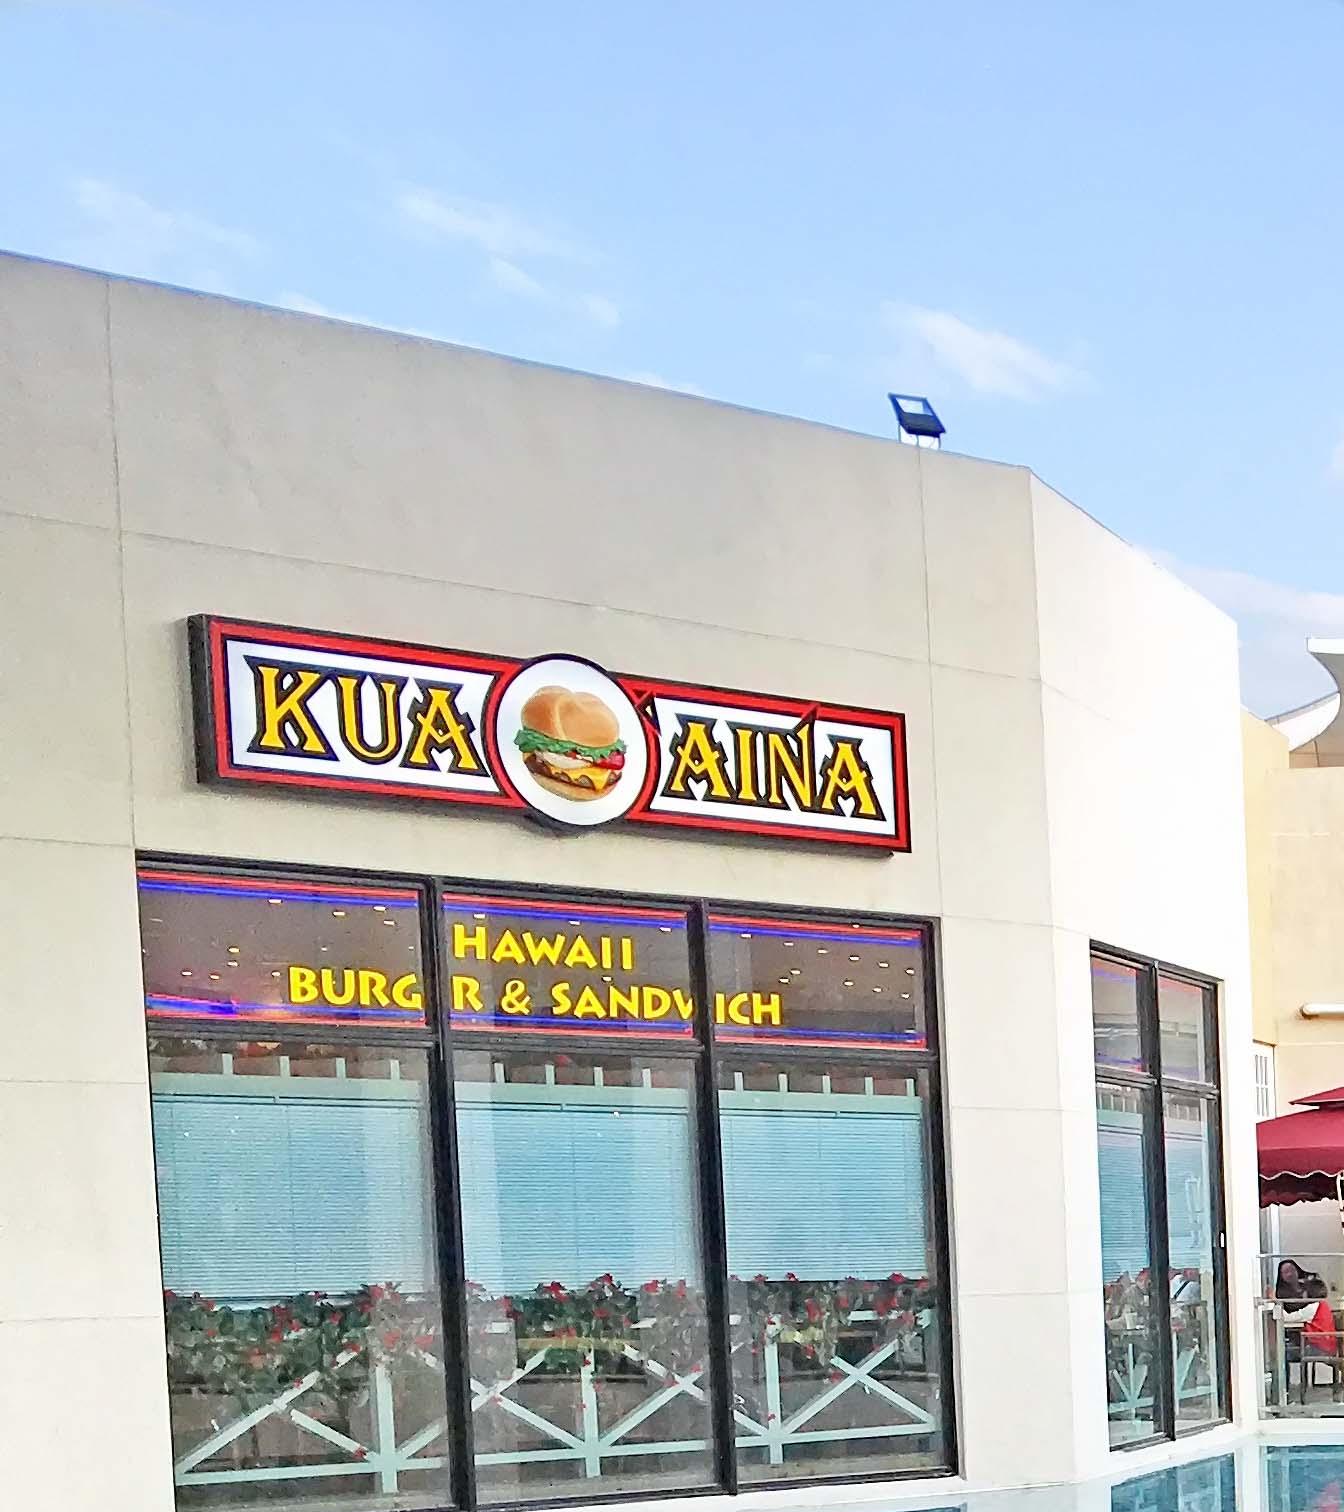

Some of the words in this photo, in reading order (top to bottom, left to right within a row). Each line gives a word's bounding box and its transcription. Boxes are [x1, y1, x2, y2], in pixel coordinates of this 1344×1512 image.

[246, 658, 488, 776] KUA
[452, 923, 635, 971] HAWAII
[288, 966, 484, 1012] BURGR
[501, 976, 531, 1015] &
